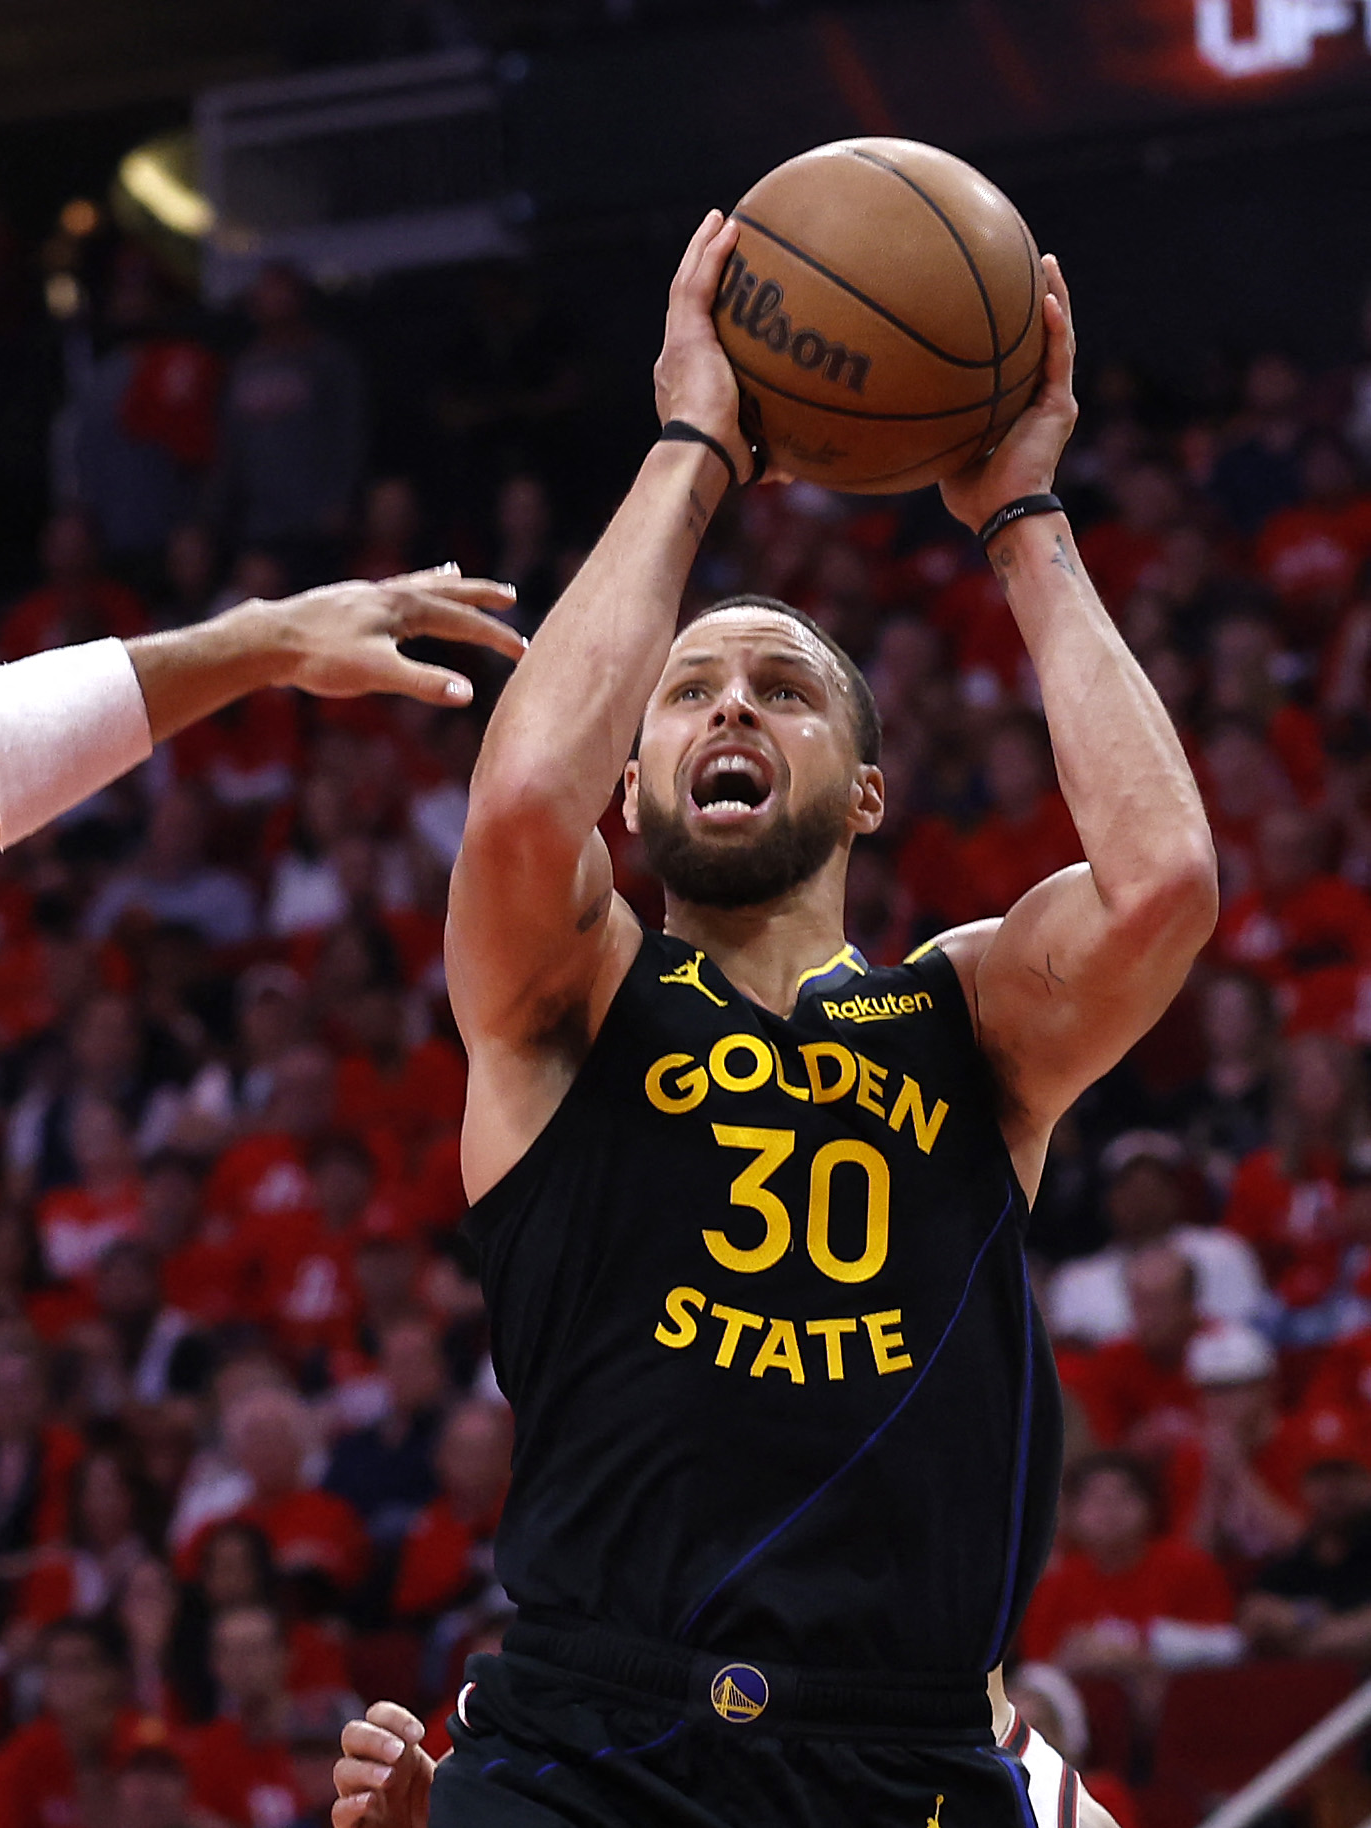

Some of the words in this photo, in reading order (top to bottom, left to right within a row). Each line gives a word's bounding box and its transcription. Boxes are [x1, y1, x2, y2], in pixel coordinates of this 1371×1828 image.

[822, 991, 933, 1023] Rakuten
[644, 1033, 949, 1155] GOLDEN
[701, 1122, 891, 1284] 30
[654, 1286, 914, 1385] STATE
